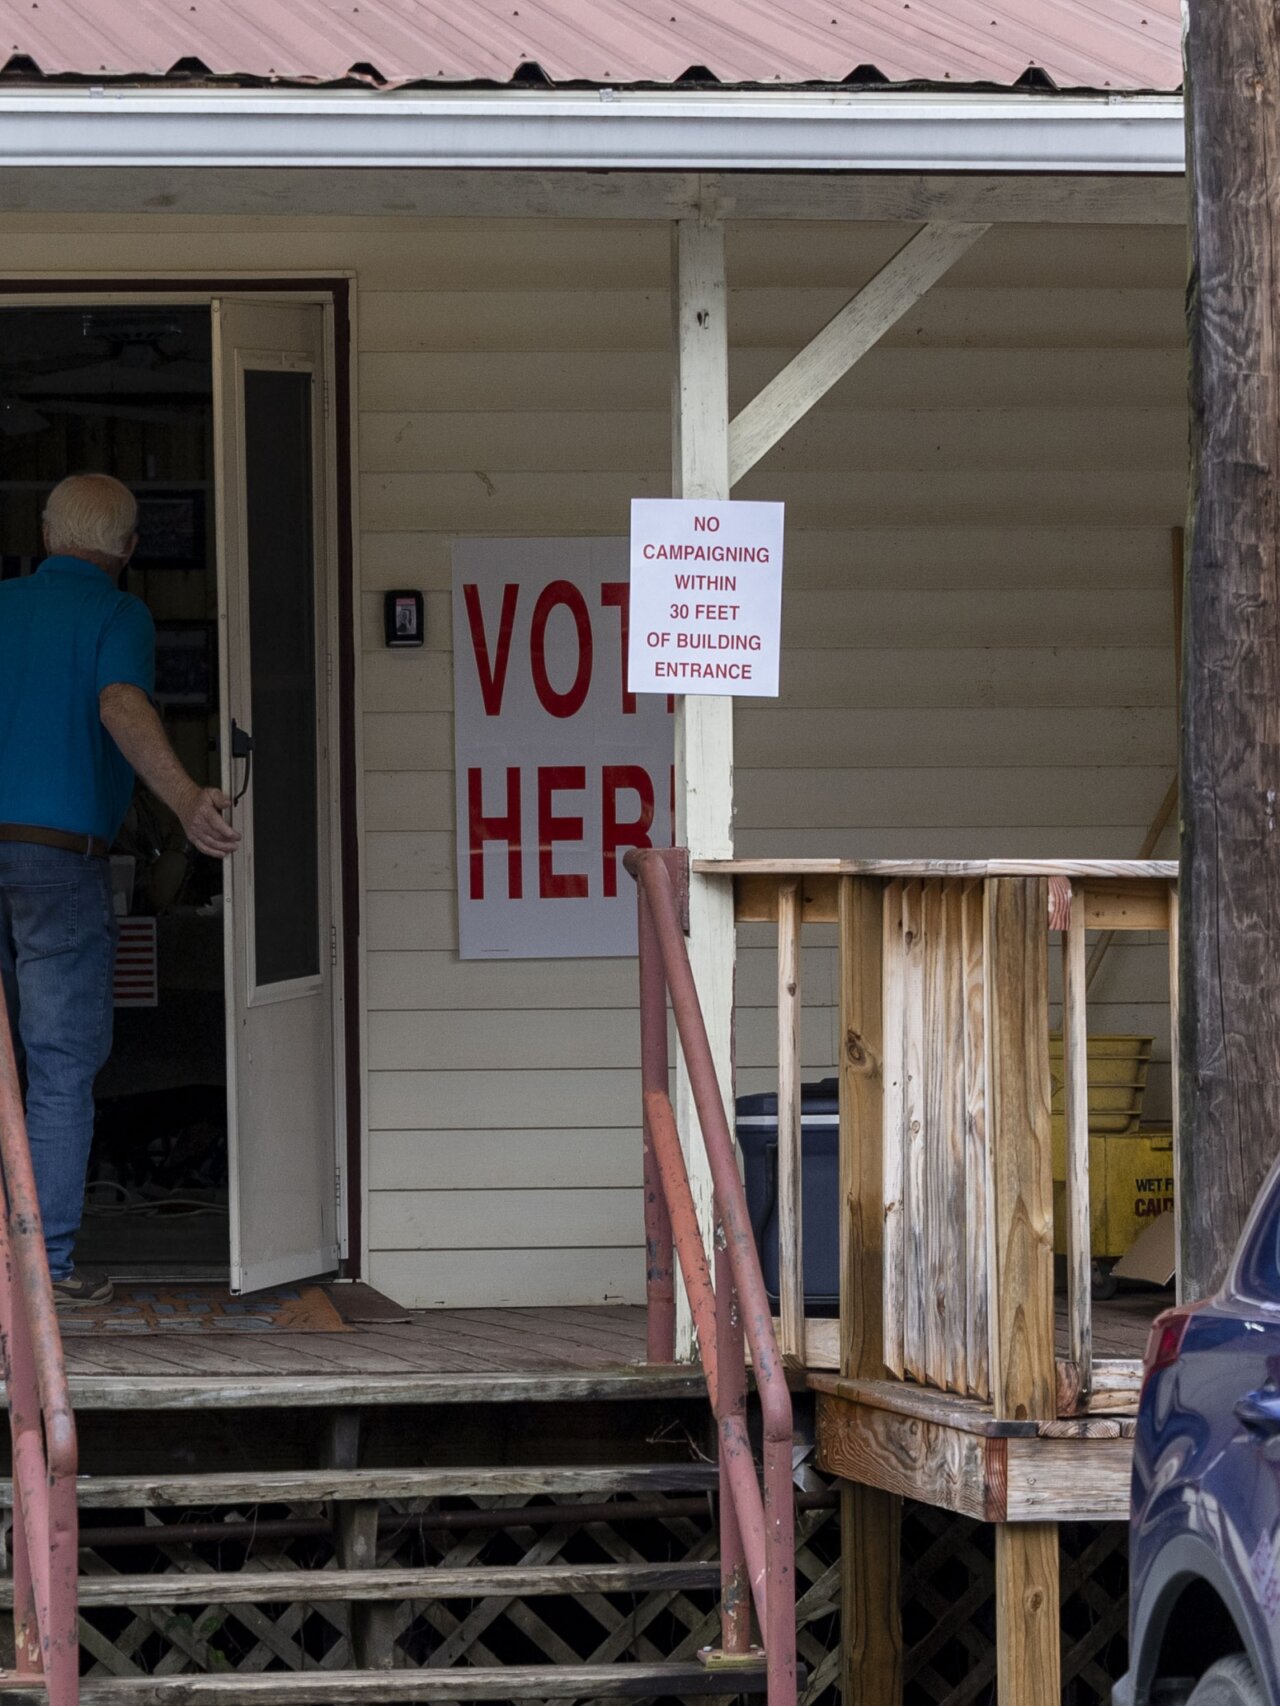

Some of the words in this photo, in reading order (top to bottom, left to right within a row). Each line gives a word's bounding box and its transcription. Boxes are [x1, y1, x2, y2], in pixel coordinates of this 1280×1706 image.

[693, 516, 720, 532] NO
[643, 544, 770, 564] CAMPAIGNING
[674, 575, 737, 591] WITHIN
[669, 604, 689, 620] 30
[695, 605, 740, 621] FEET
[462, 579, 674, 718] VOT
[647, 632, 671, 648] OF
[676, 633, 762, 651] BUILDING
[655, 662, 752, 680] ENTRANCE
[467, 765, 675, 900] HER
[1136, 1178, 1162, 1192] WET
